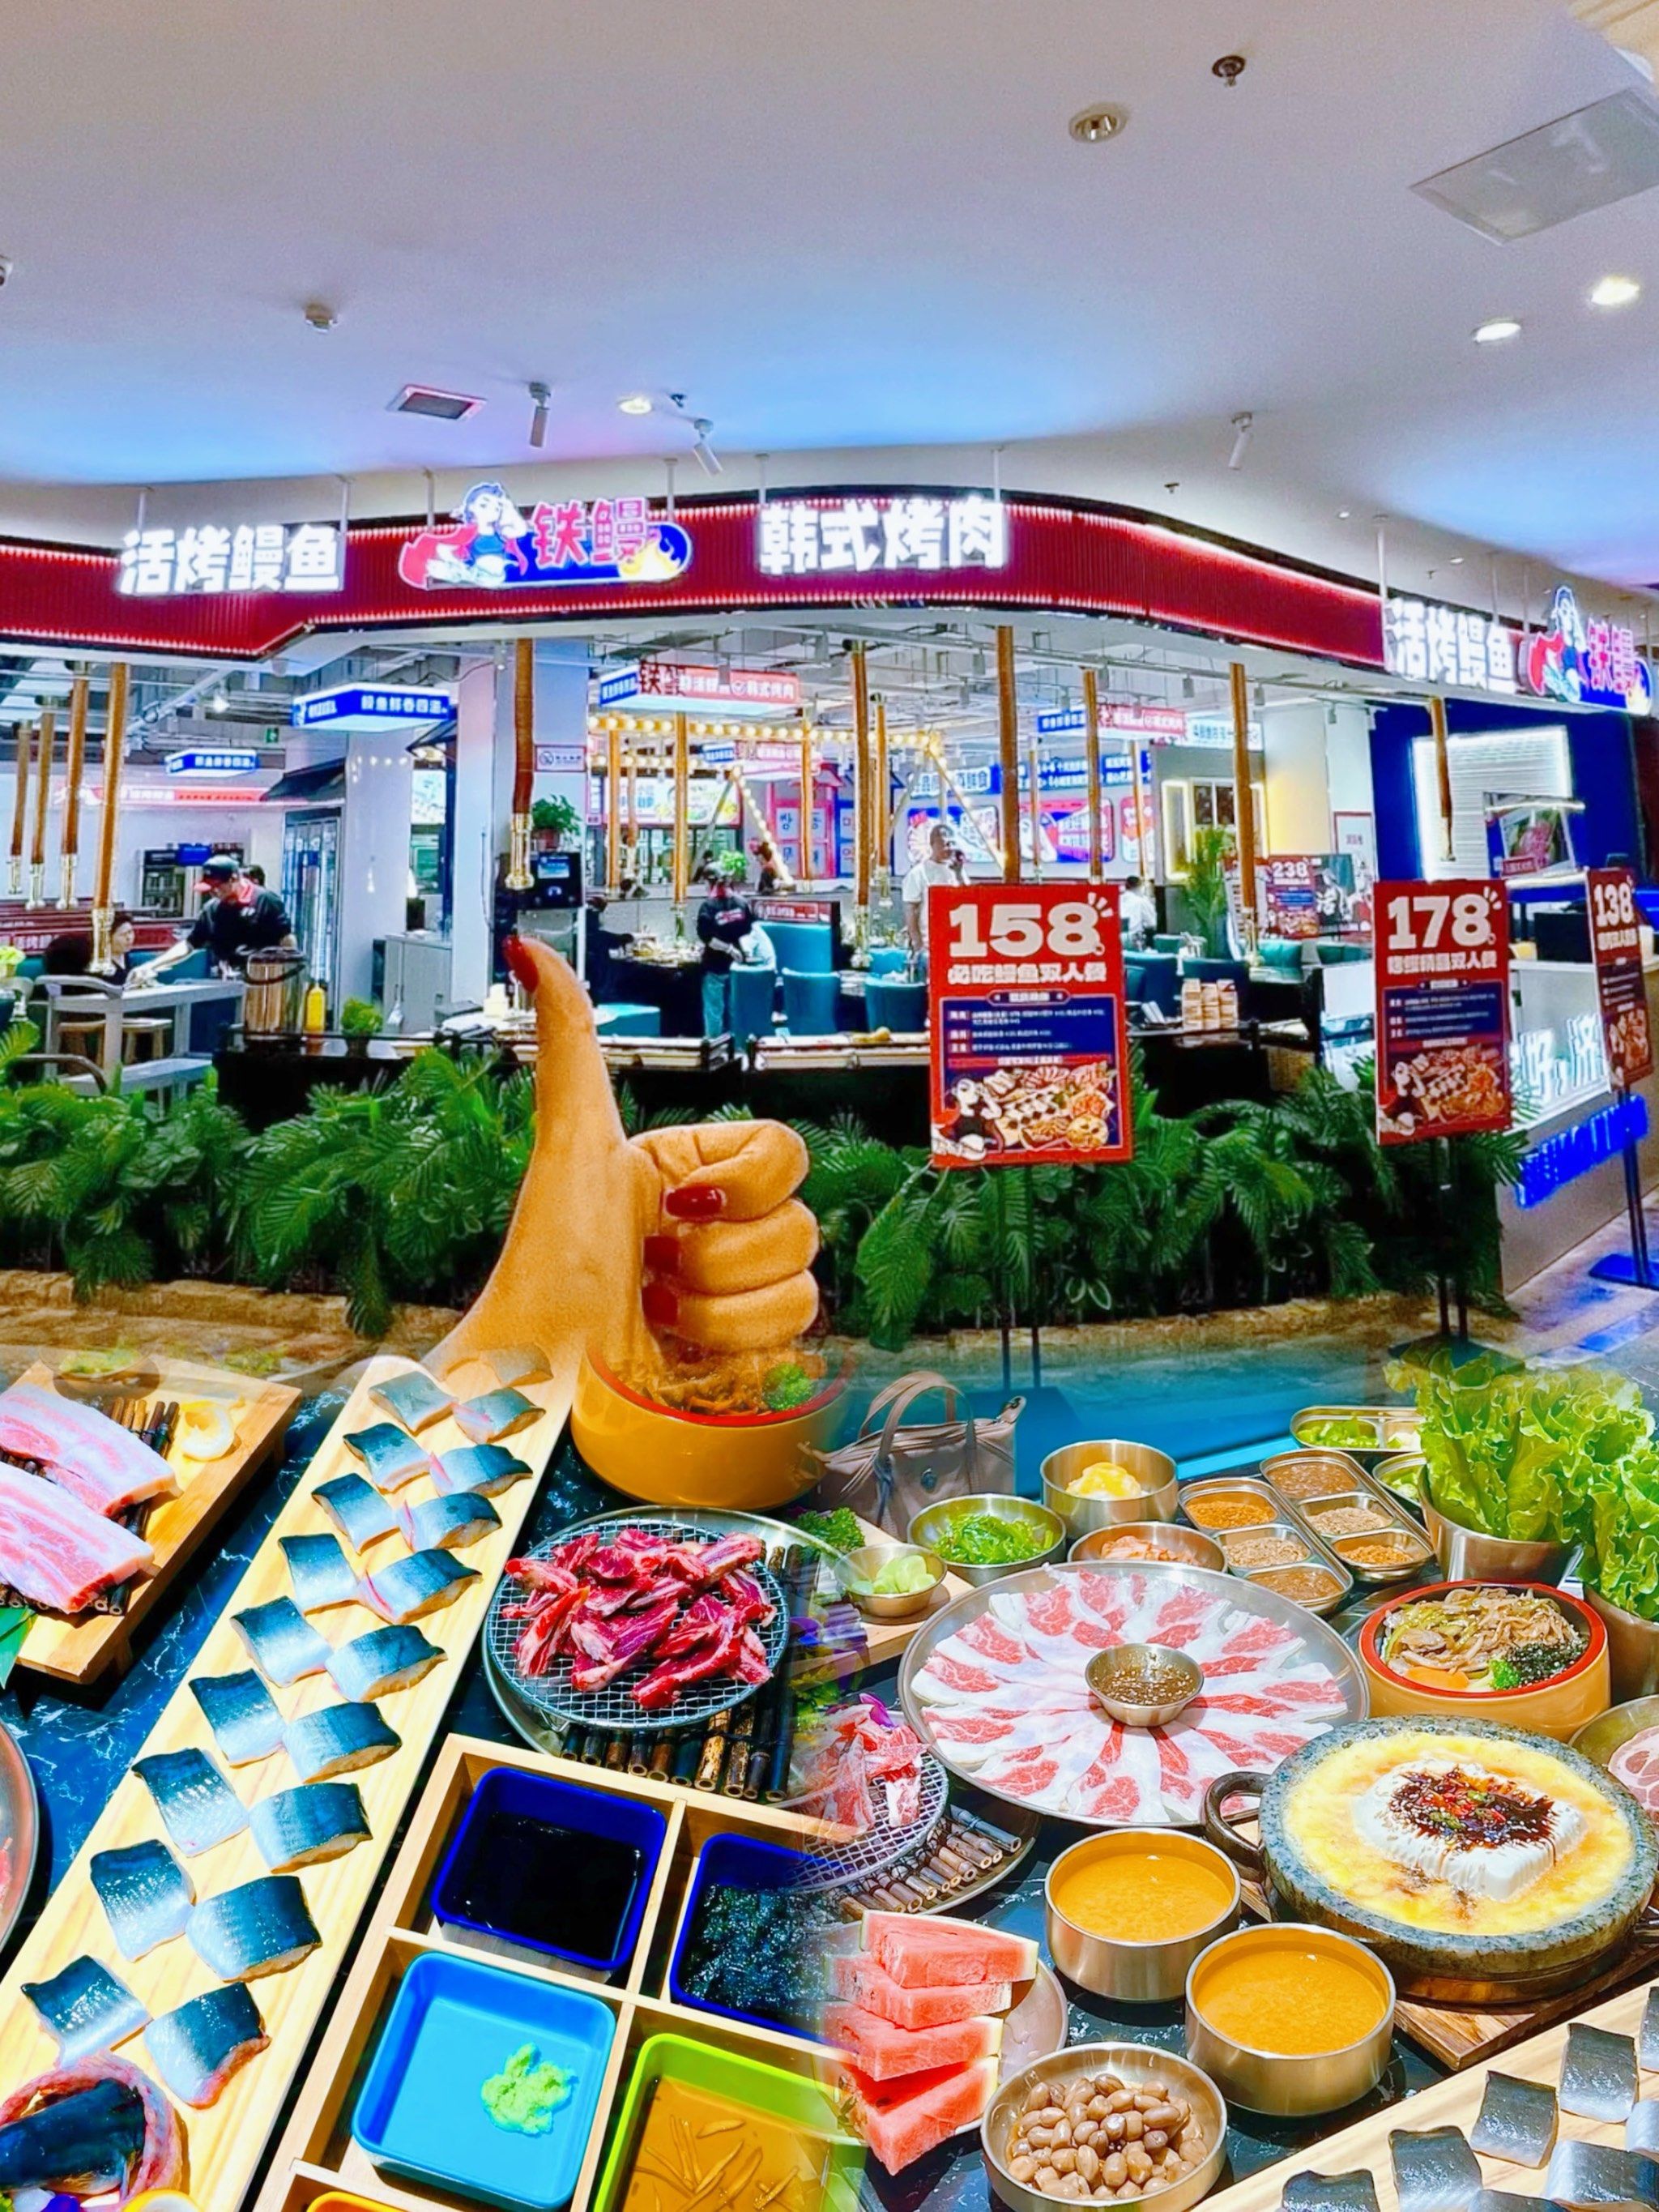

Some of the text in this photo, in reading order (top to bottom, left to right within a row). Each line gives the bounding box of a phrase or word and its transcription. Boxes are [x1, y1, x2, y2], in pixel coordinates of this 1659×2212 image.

[117, 524, 342, 595] 活烤鳗鱼
[531, 497, 646, 569] 铁鳗
[760, 496, 1007, 574] 韩式烤肉
[1384, 597, 1516, 695] 活烤鳗鱼
[948, 901, 1103, 958] 158
[1387, 893, 1492, 950] 178
[1593, 882, 1635, 928] 138
